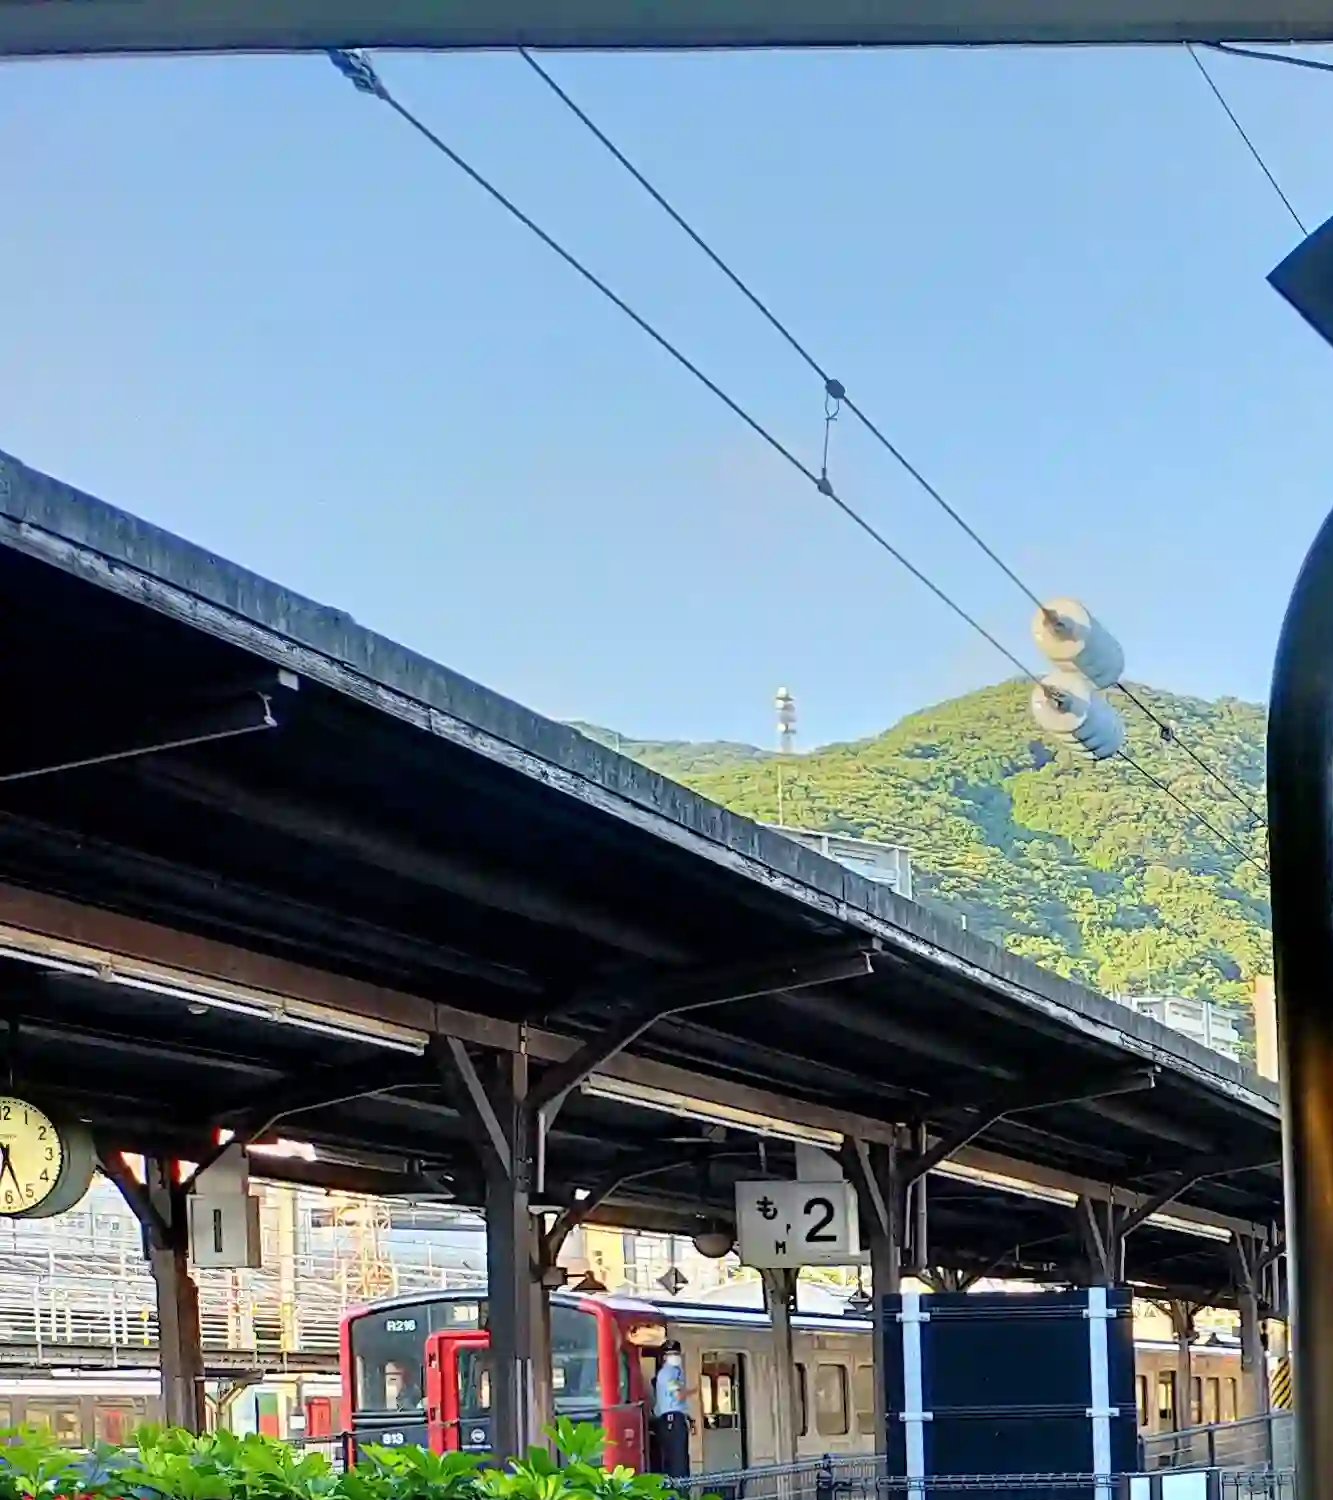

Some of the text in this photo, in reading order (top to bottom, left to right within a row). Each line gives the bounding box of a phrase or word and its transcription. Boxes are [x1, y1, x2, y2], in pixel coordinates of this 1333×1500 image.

[38, 1126, 47, 1141] 2
[44, 1147, 54, 1161] 3
[39, 1168, 49, 1183] 4
[5, 1190, 13, 1204] 6
[25, 1183, 34, 1198] 5
[756, 1196, 837, 1242] も 2
